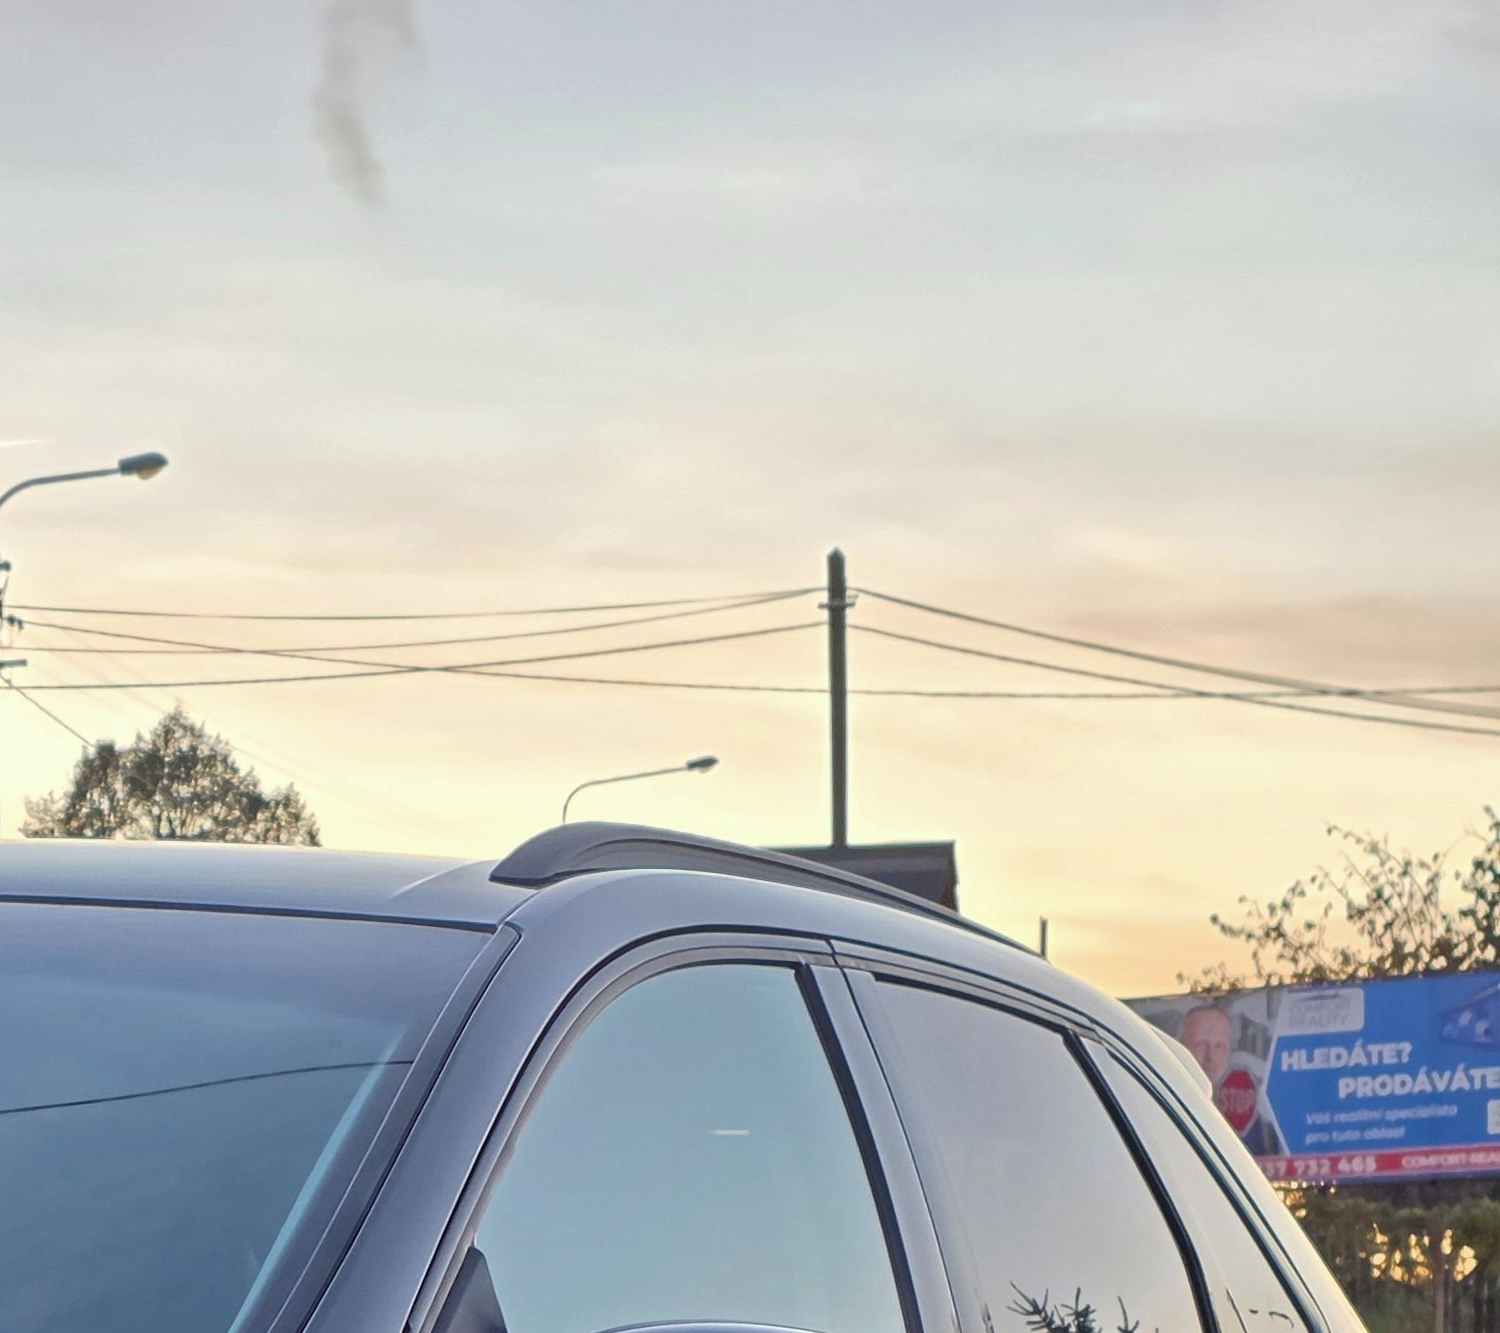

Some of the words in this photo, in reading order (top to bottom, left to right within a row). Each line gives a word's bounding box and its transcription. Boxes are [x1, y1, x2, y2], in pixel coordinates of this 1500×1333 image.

[1281, 1038, 1412, 1072] HLEDÁTE?
[1338, 1062, 1500, 1099] PRODÁVÁTE
[1219, 1087, 1255, 1115] STOP
